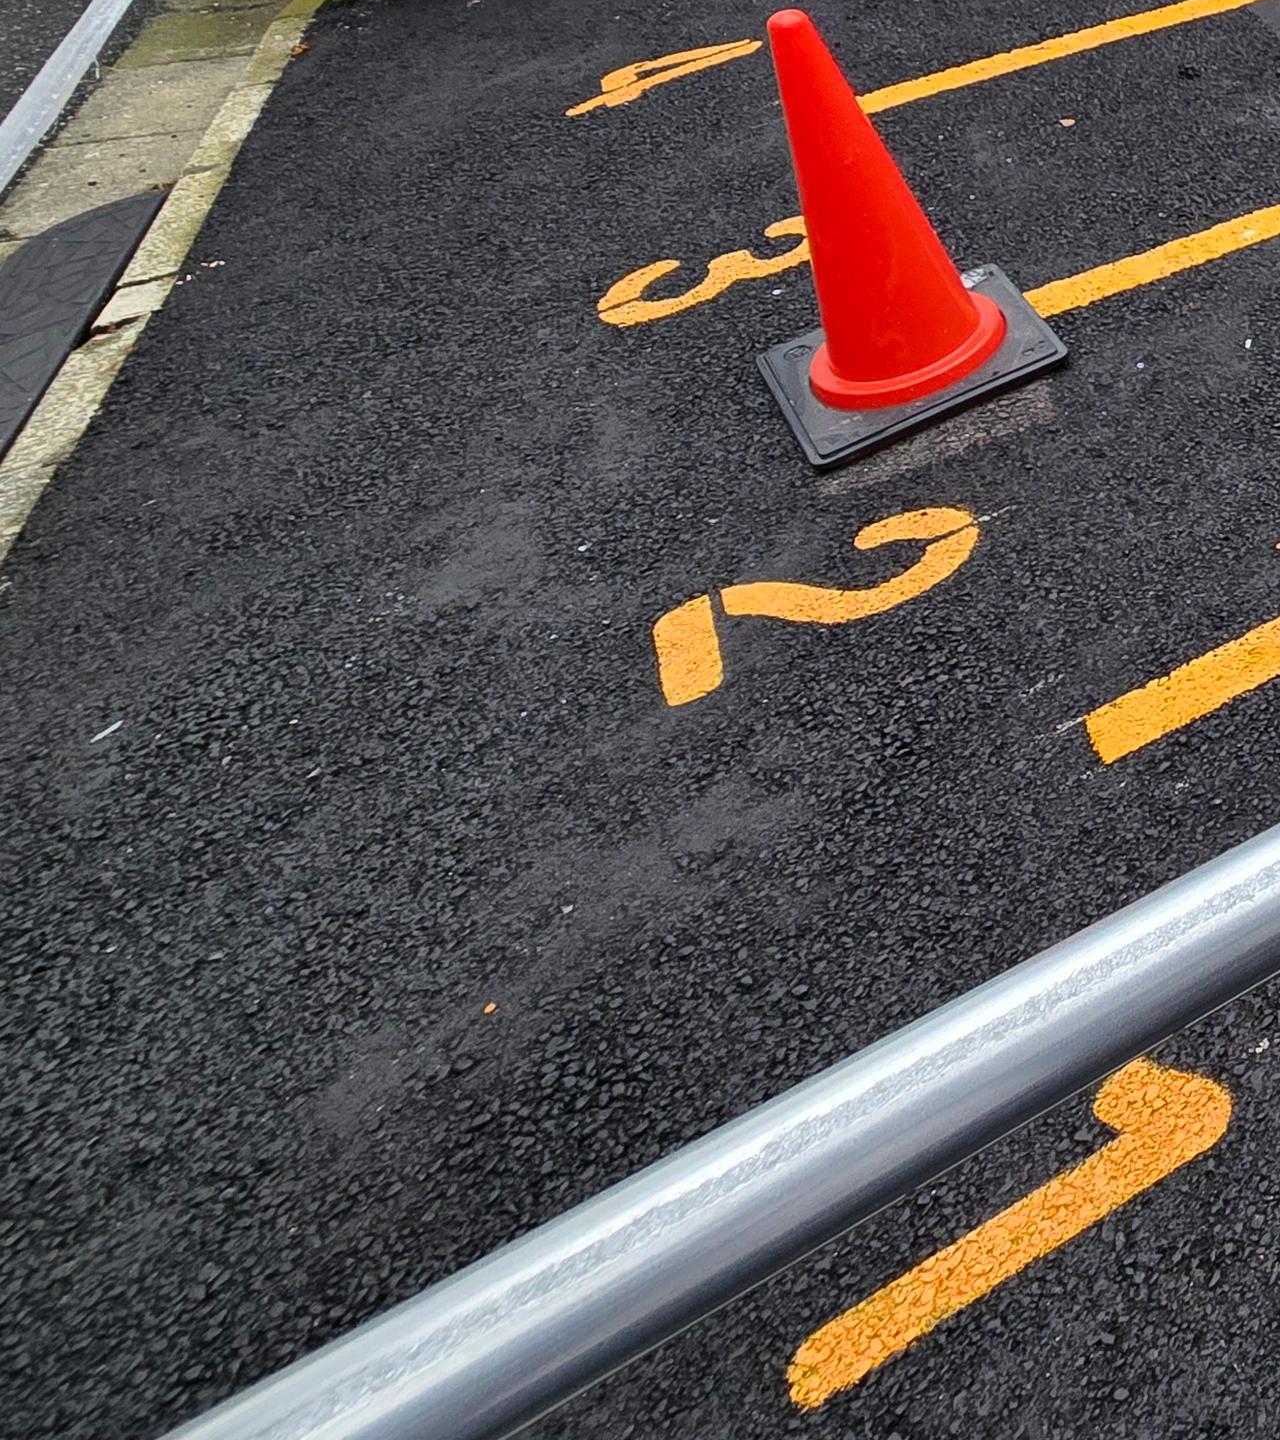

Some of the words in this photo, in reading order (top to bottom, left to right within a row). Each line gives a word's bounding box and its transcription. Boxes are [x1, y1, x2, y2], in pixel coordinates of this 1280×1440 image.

[597, 215, 815, 328] 3
[653, 506, 981, 708] 2
[786, 1056, 1233, 1410] 1
